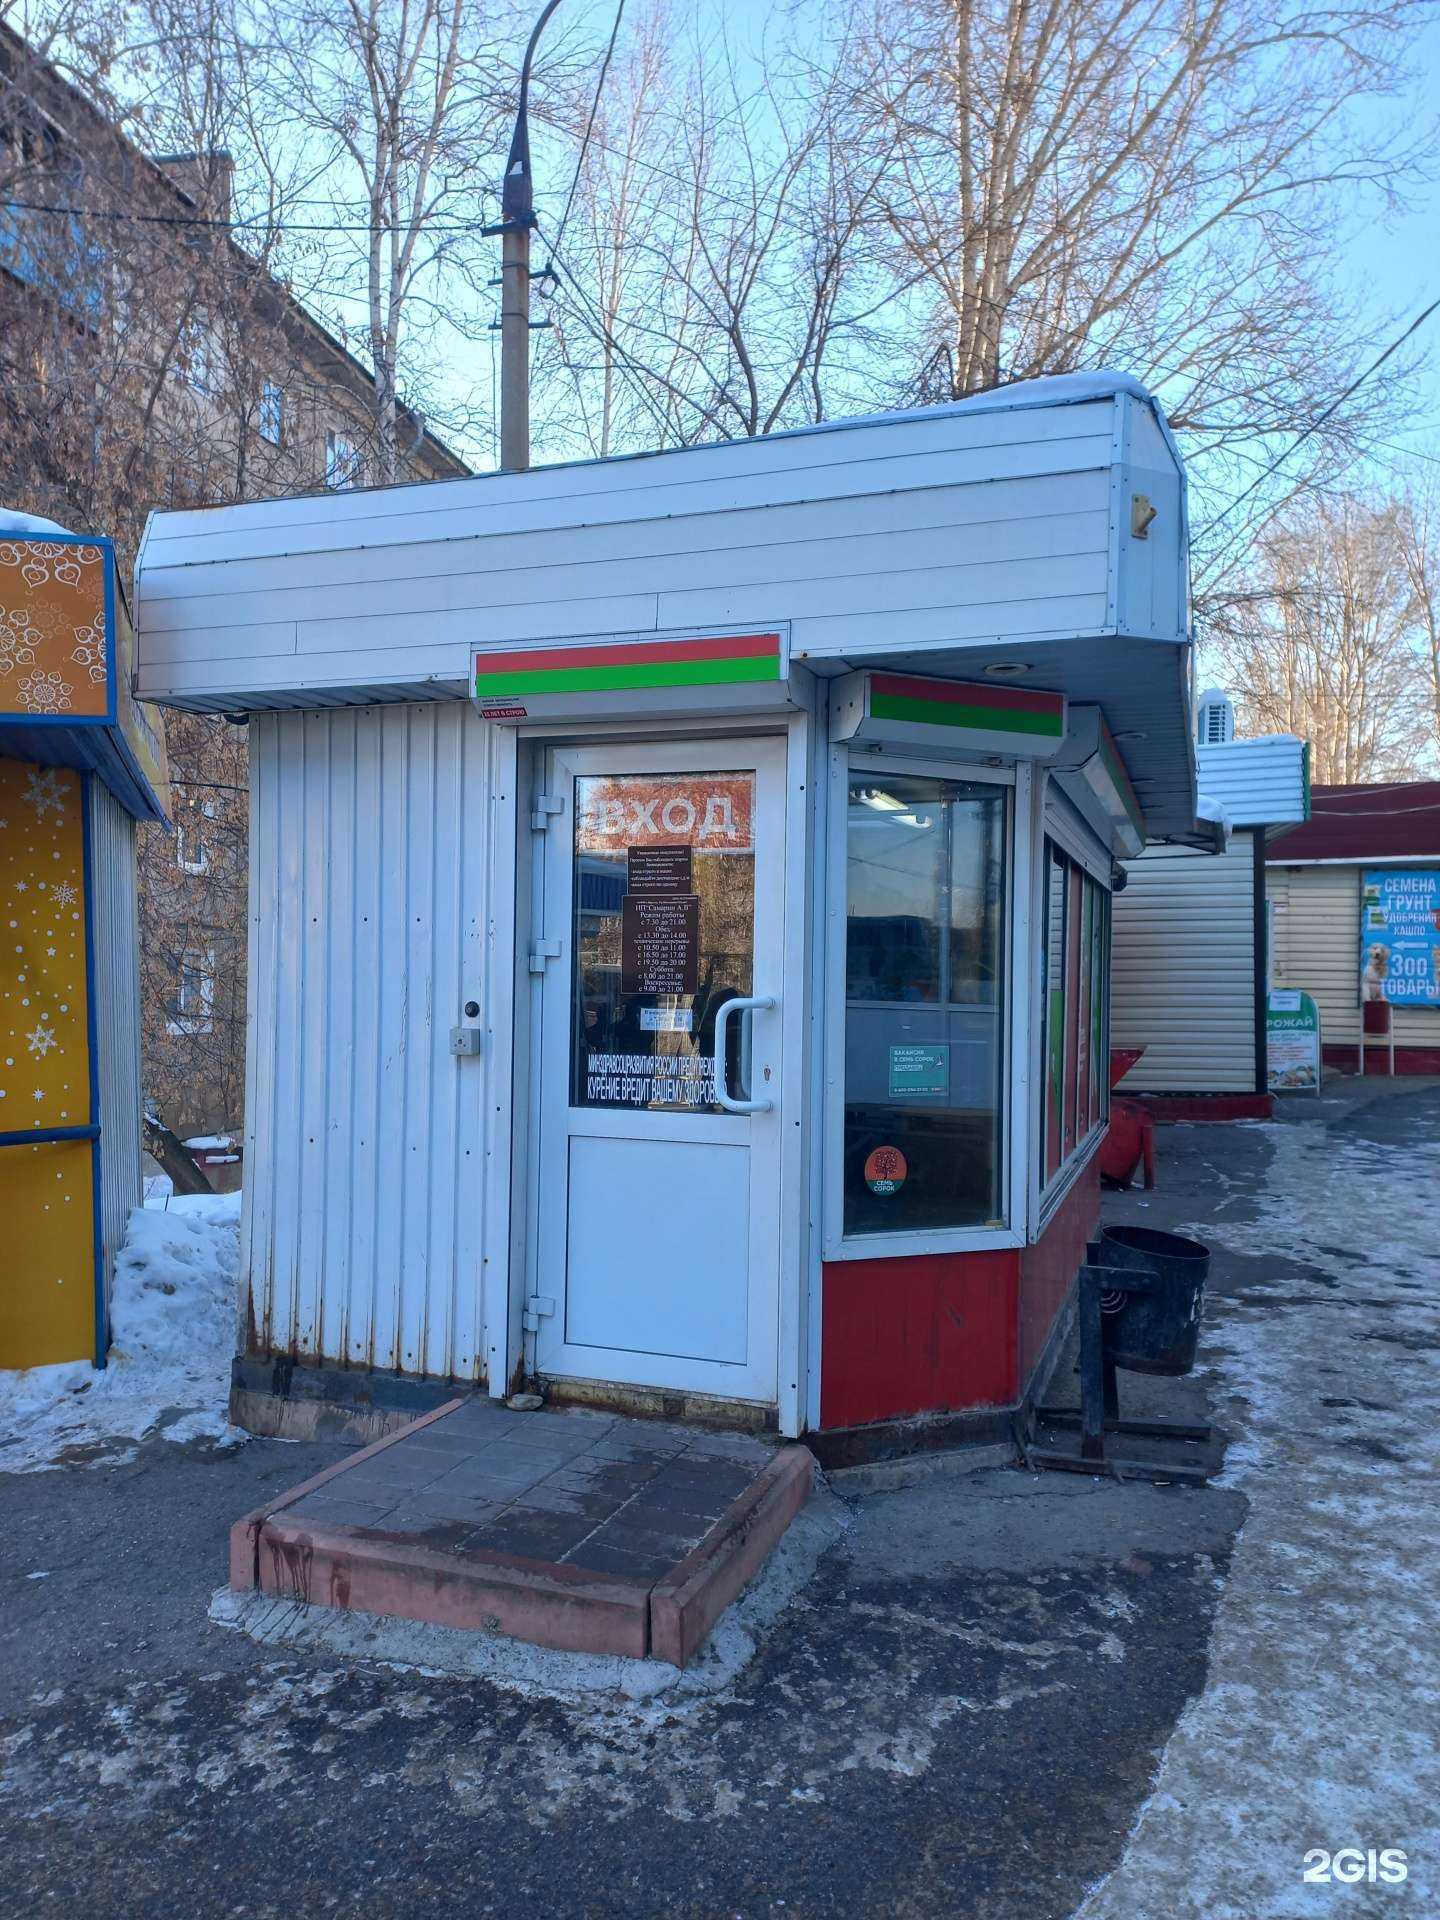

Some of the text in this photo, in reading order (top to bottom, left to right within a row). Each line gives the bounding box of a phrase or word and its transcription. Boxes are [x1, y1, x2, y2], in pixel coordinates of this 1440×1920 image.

[599, 796, 737, 839] ВХОД
[1384, 879, 1437, 892] СЕМЕНА
[1388, 895, 1432, 910] ГРУНТ
[1391, 954, 1428, 976] ЗОО
[1381, 979, 1440, 996] ТОВАРЫ
[1266, 1016, 1314, 1029] РОЖАЙ
[588, 1054, 728, 1079] МИНЗДРАВСОЦРАЗВИТИЯ РОССИИ ПРЕДУПРЕЖД:
[587, 1077, 727, 1107] КУРЕНИЕ ВРЕДИТ ВАШЕМУ ЗДОРОВ
